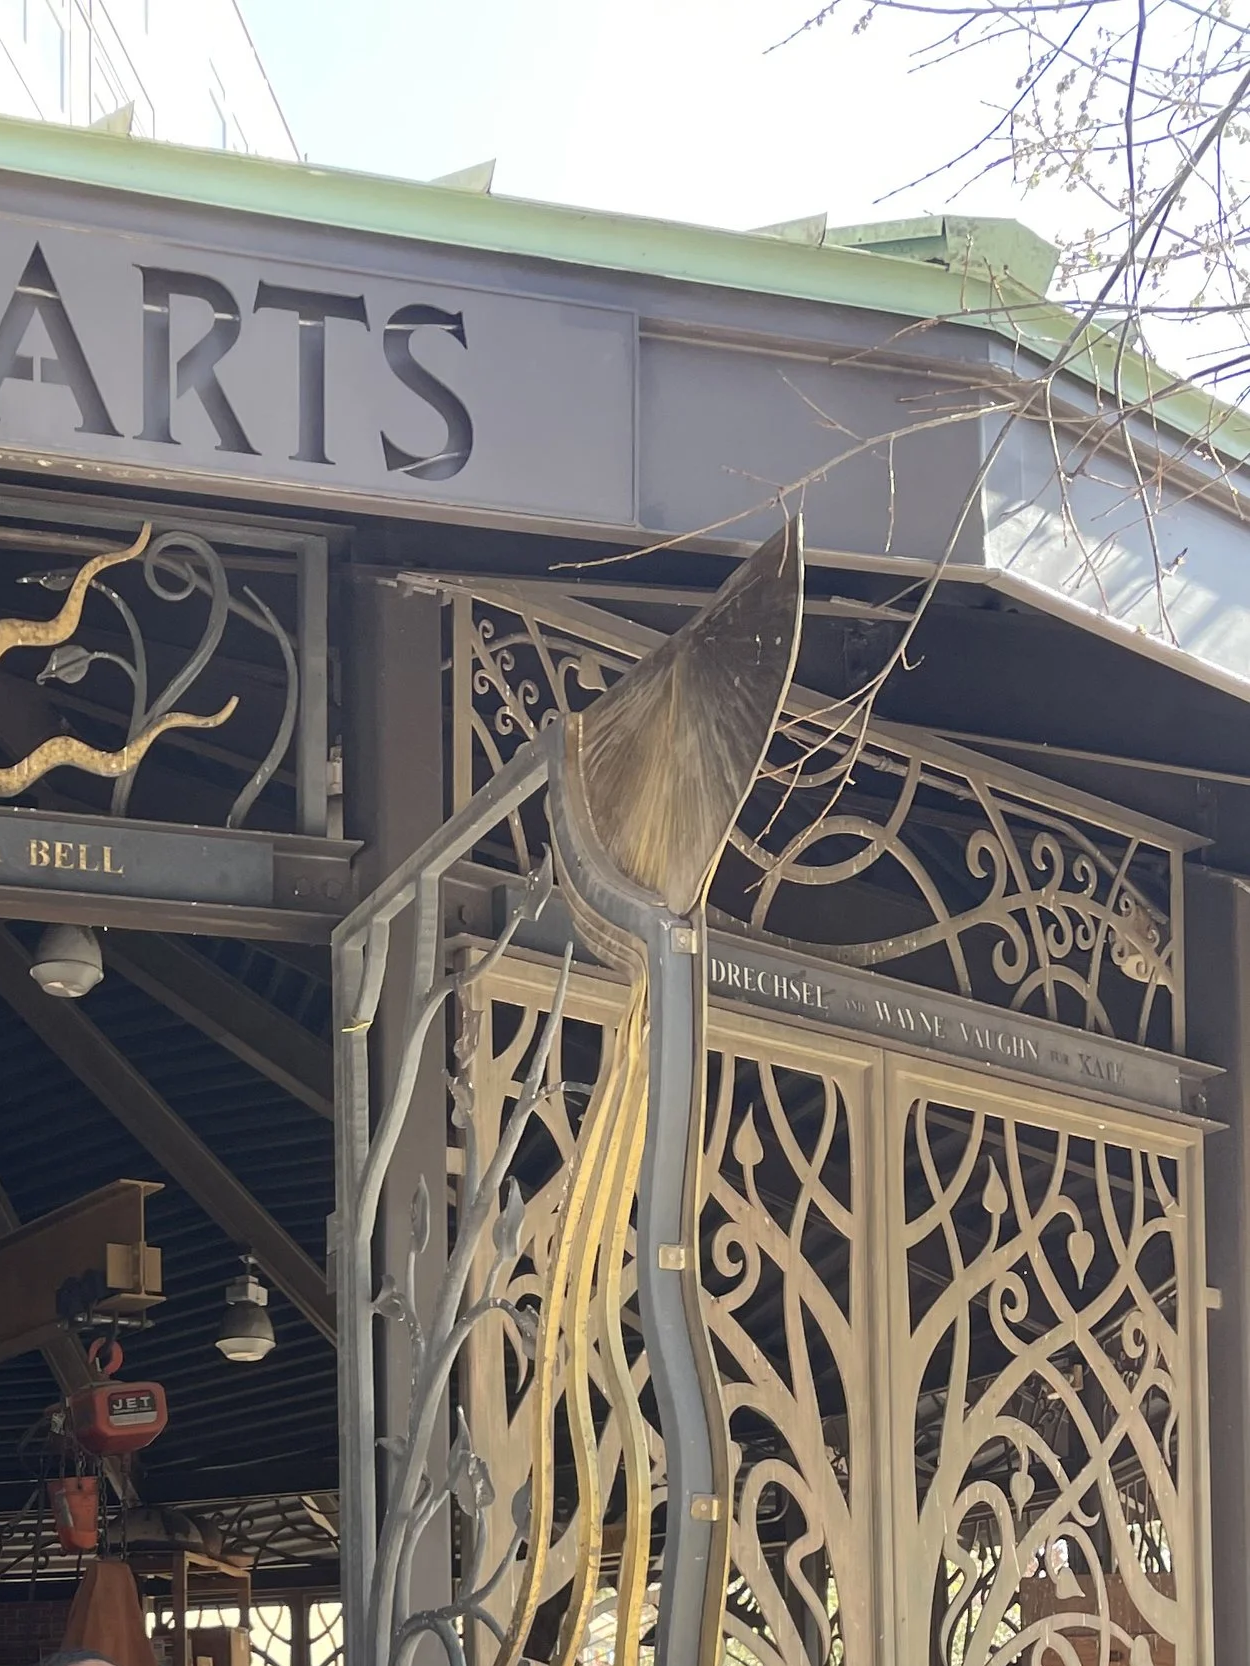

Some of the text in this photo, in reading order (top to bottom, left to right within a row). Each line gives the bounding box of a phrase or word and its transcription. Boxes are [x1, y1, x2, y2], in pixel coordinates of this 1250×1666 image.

[29, 839, 124, 874] BELL
[711, 958, 829, 1009] DRECHSEL
[874, 1000, 946, 1039] WAYNE
[960, 1022, 1039, 1060] VAUGHN
[112, 1396, 151, 1410] JET
